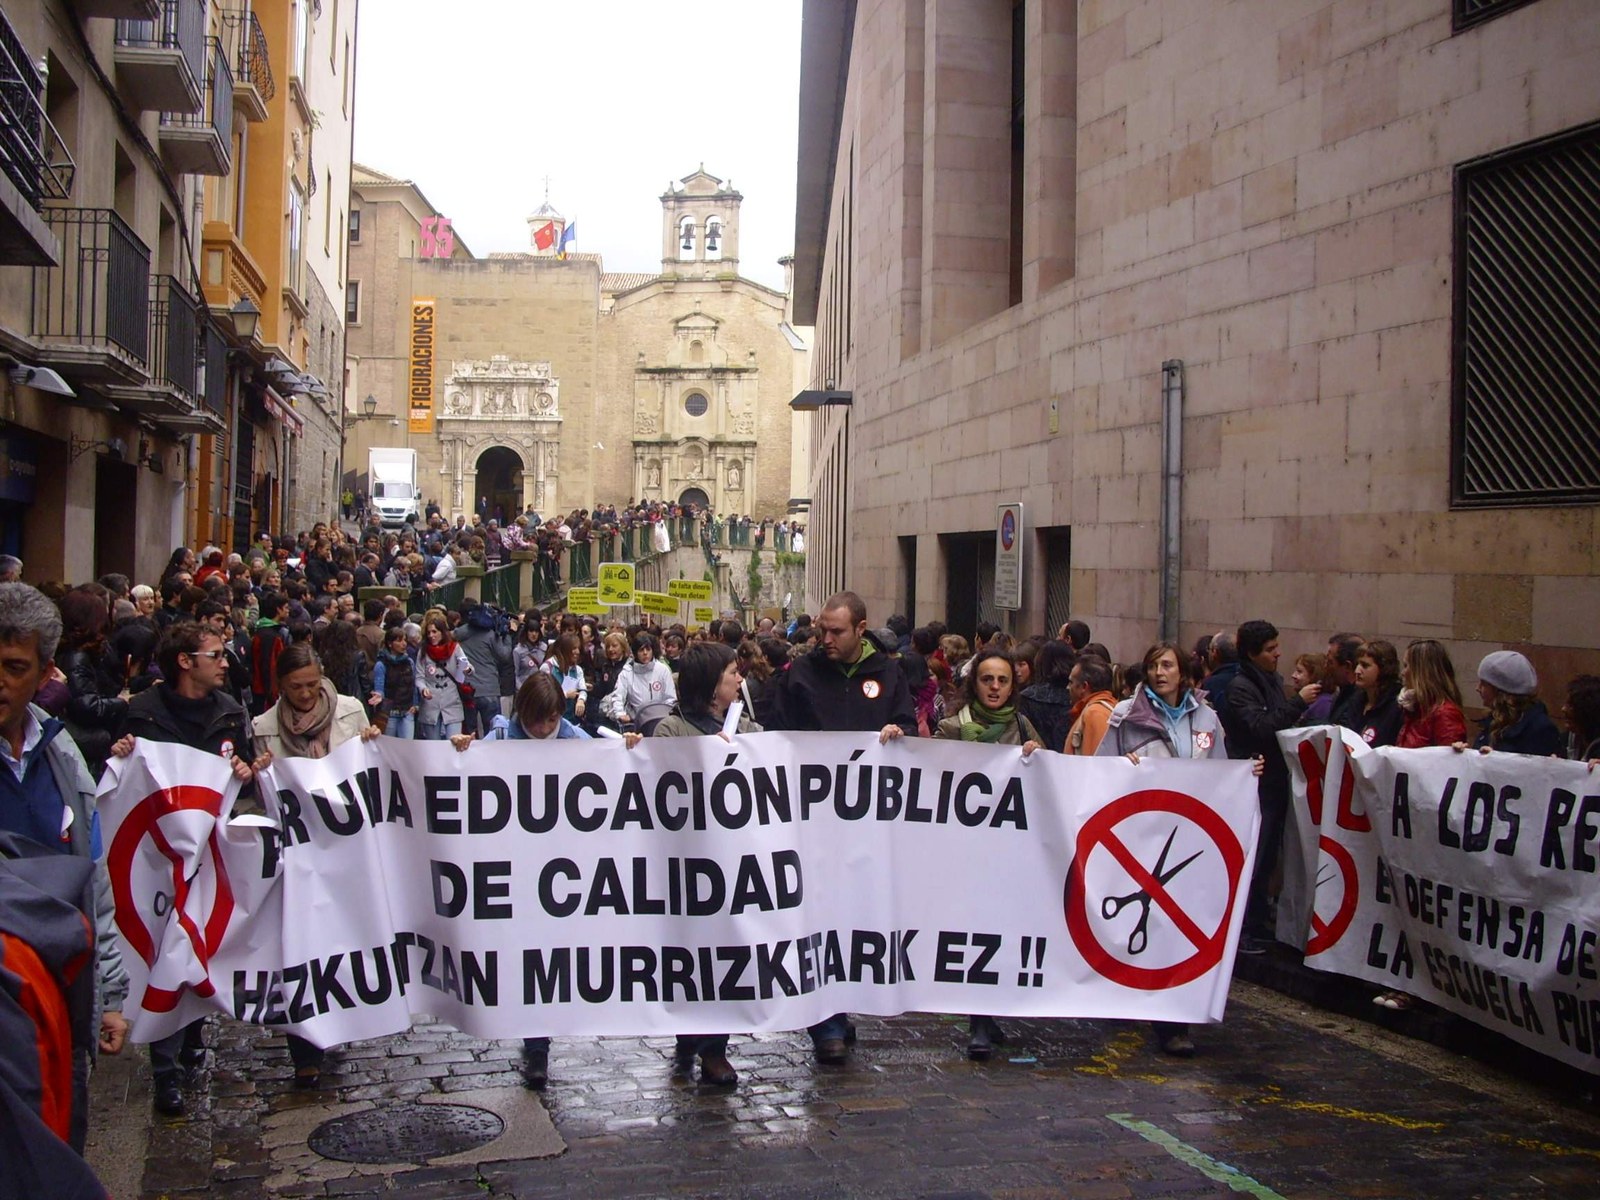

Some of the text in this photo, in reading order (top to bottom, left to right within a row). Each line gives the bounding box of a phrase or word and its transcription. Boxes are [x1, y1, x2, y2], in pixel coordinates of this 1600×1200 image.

[411, 306, 433, 410] FIGURACIONES
[424, 753, 792, 834] EDUCACIÓN
[800, 750, 1028, 830] PÚBLICA
[1392, 772, 1412, 839] A
[1438, 777, 1522, 856] LOS
[430, 849, 803, 919] DE CALIDAD
[1376, 856, 1598, 980] E DEFENSA DE
[523, 930, 920, 1005] MURRIZKETARIK
[934, 930, 1002, 986] EZ
[1367, 923, 1414, 979] LA
[1421, 941, 1544, 1035] ESCUELA
